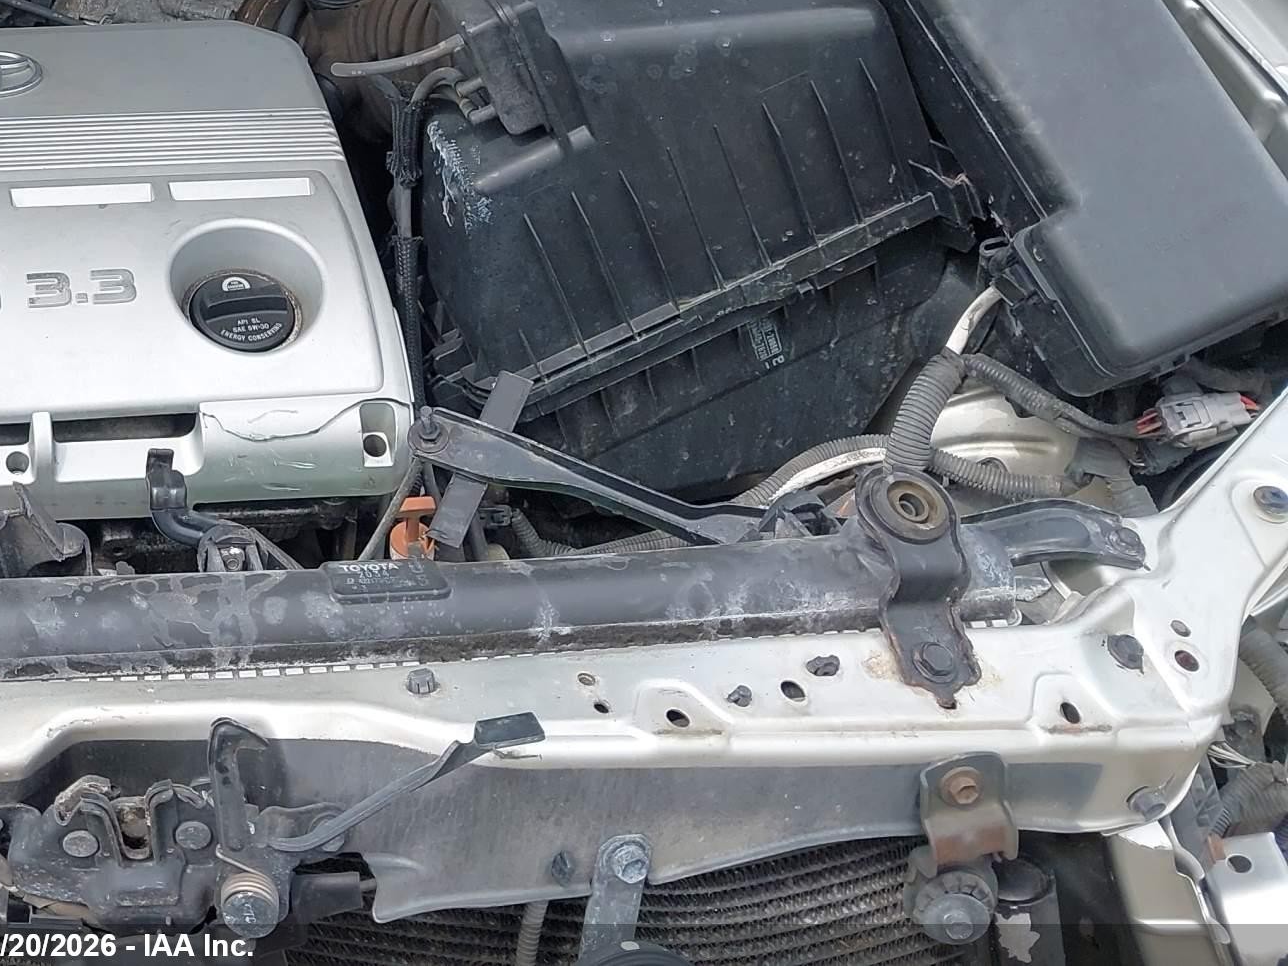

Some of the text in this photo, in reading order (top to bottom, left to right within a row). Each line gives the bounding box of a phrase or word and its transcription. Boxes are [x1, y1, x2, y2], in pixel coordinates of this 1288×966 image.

[26, 268, 137, 308] 3.3
[220, 322, 283, 342] ENERGY CONSERVING
[339, 562, 400, 573] TOYOTA
